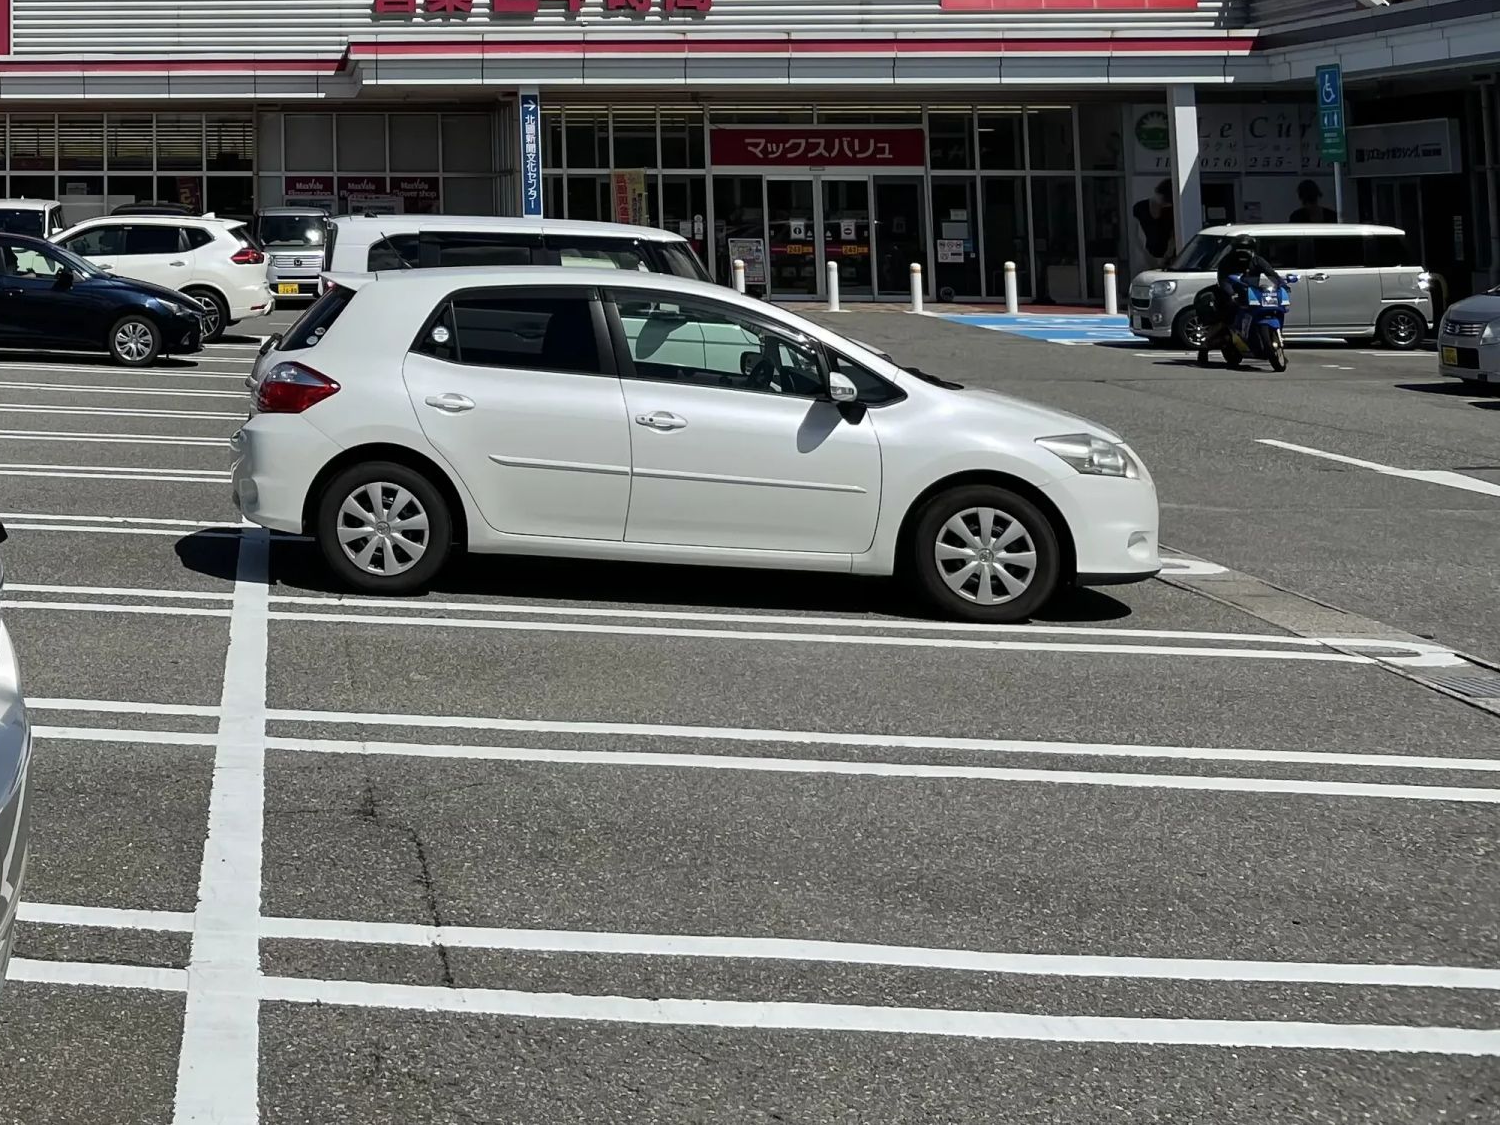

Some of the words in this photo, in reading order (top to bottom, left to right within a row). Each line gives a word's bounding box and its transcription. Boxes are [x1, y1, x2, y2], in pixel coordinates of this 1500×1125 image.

[744, 137, 894, 160] マックスバリュ
